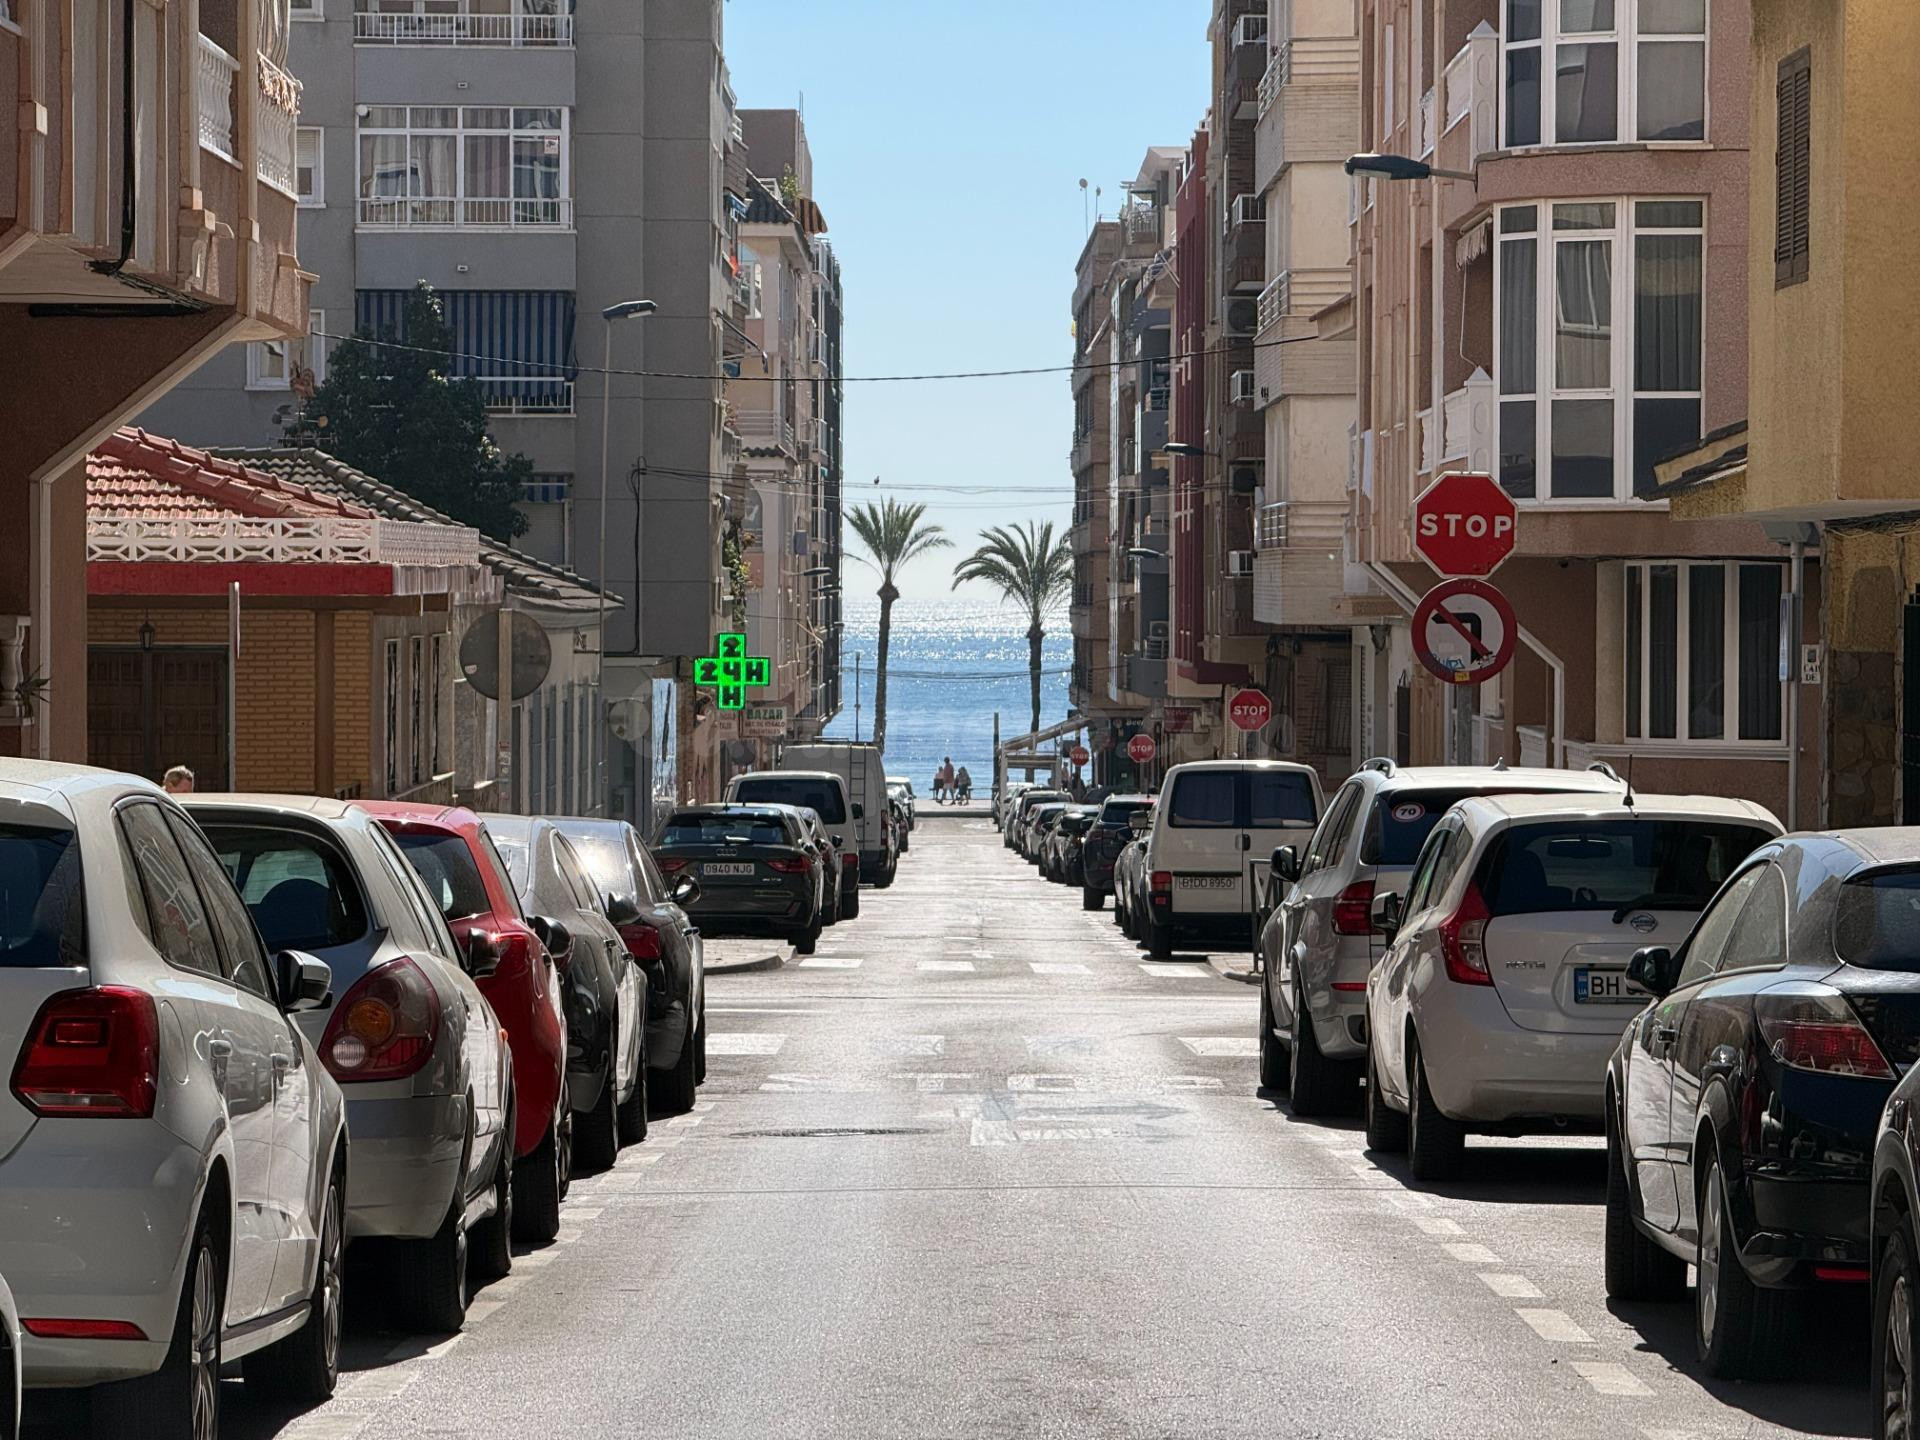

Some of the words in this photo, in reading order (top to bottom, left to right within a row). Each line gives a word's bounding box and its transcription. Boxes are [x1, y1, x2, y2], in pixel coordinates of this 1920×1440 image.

[1420, 513, 1512, 538] STOP
[747, 709, 783, 720] BAZAR
[1233, 704, 1267, 716] STOP
[1131, 745, 1153, 753] STOP
[1400, 805, 1417, 816] 70
[705, 864, 731, 873] 0940
[733, 864, 752, 873] NJG
[1209, 878, 1232, 888] 8950
[1591, 976, 1620, 995] BH
